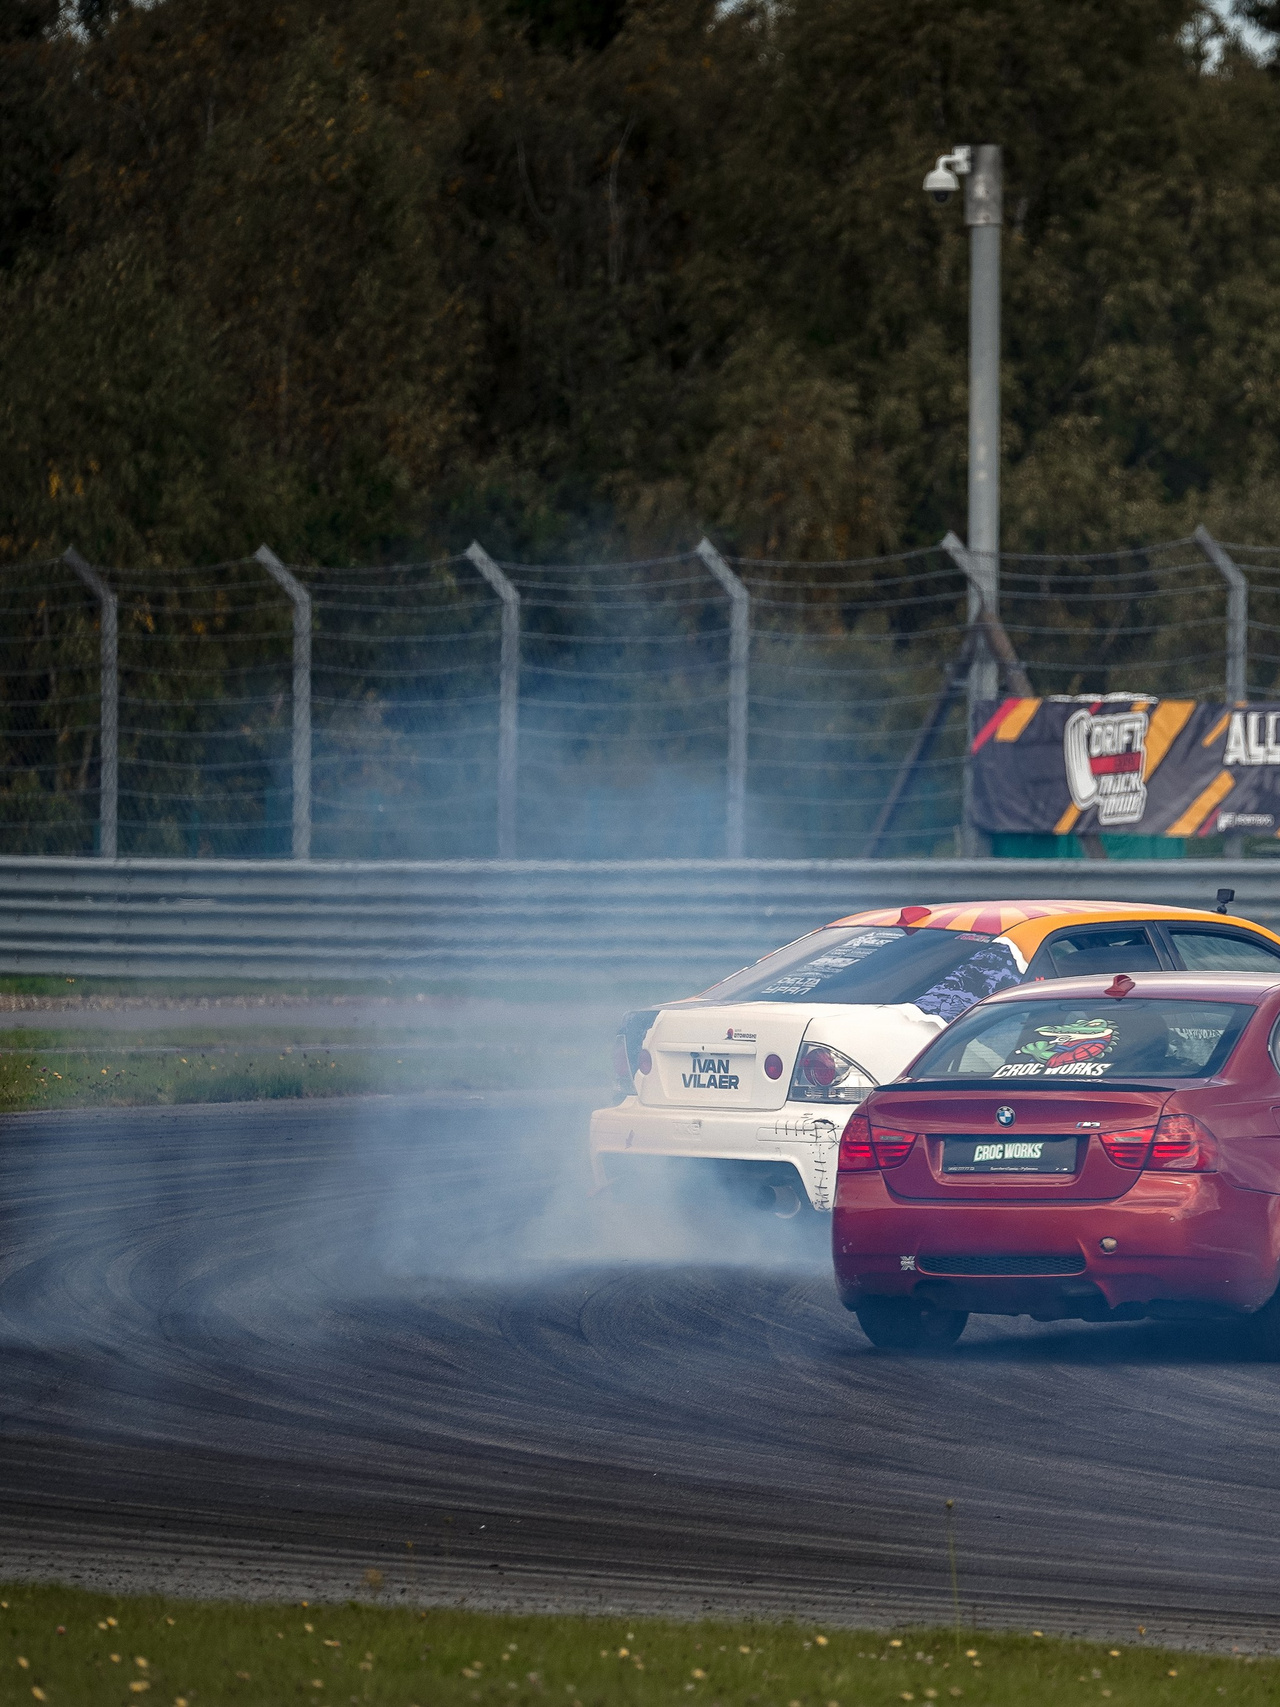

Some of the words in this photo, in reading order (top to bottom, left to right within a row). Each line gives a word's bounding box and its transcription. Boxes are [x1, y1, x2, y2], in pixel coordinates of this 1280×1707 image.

[777, 976, 821, 988] DELTA
[692, 1058, 730, 1074] IVAN
[991, 1063, 1045, 1078] CROC
[1044, 1062, 1112, 1077] WORKS
[682, 1073, 740, 1090] VILAER
[973, 1144, 1004, 1162] CROC
[1004, 1142, 1045, 1159] WORKS
